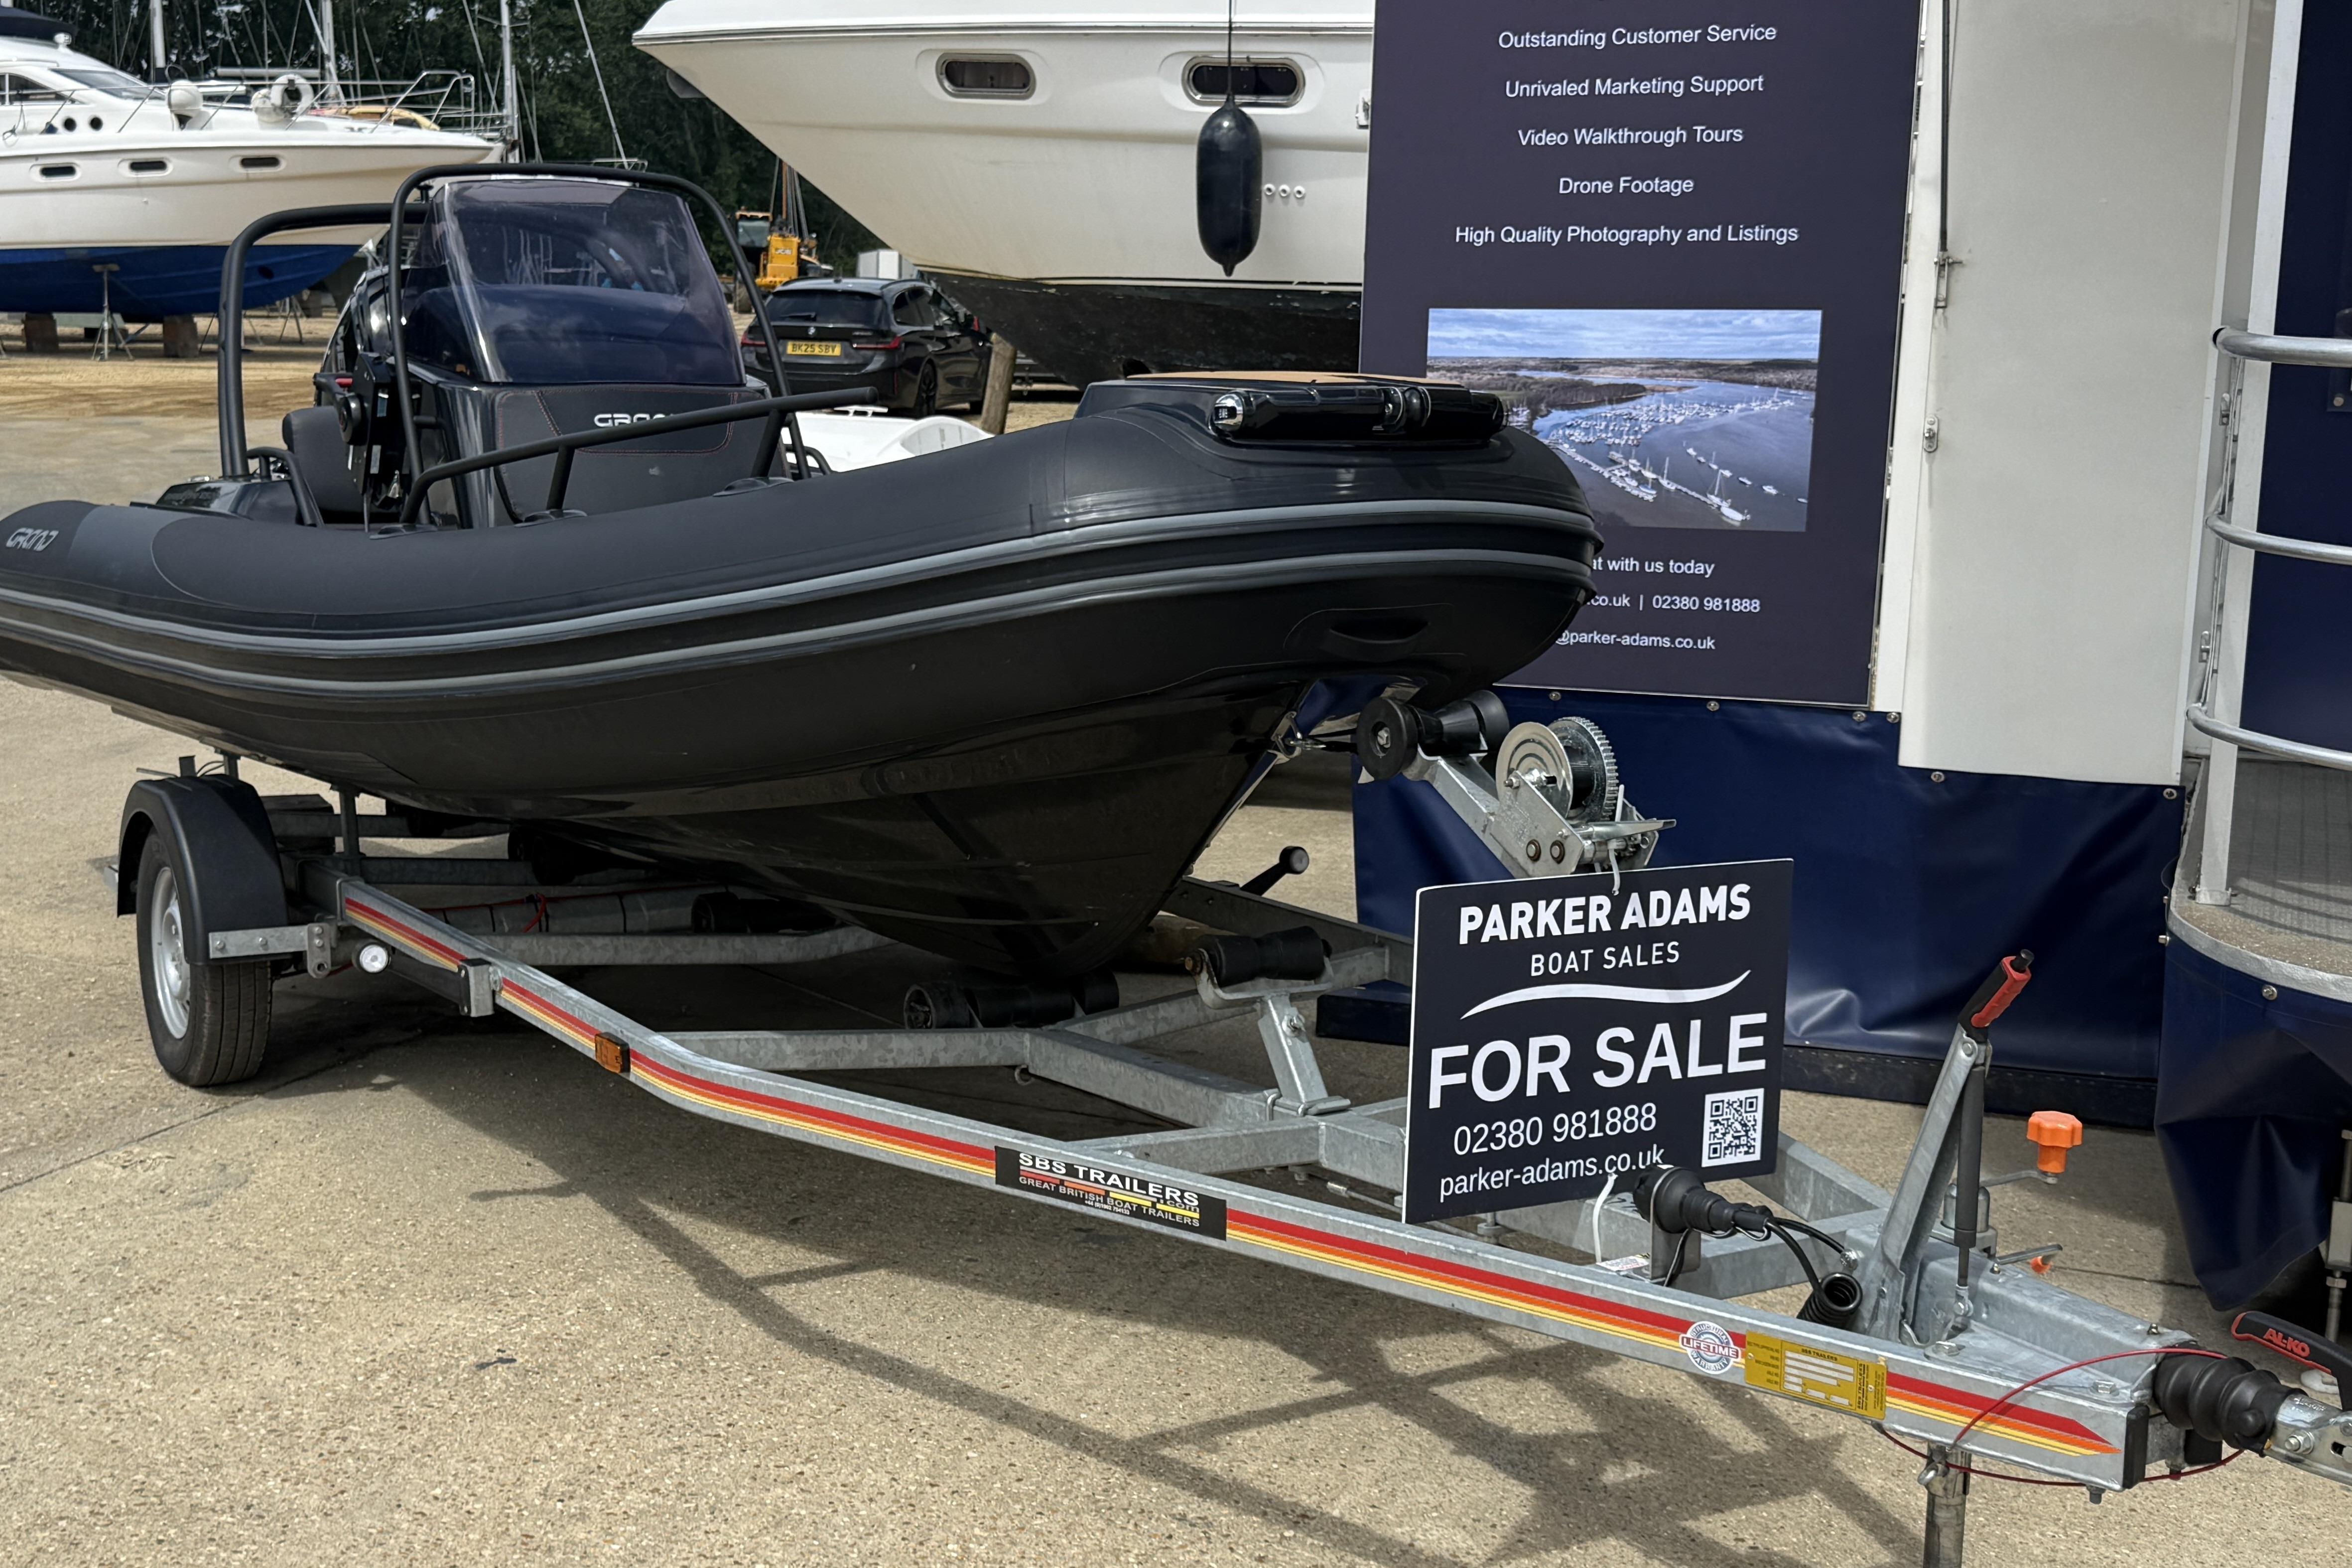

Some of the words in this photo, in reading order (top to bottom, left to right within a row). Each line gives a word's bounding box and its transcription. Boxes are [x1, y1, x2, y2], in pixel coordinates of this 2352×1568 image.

[1498, 29, 1606, 50] Outstanding
[1611, 27, 1702, 45] Customer
[1706, 24, 1777, 42] Service
[1505, 78, 1589, 98] Unrivaled
[1594, 76, 1684, 97] Marketing
[1690, 75, 1764, 96] Support
[1518, 129, 1568, 146] Video
[1573, 127, 1687, 147] Walkthrough
[1693, 125, 1743, 143] Tours
[1559, 177, 1613, 194] Drone
[1619, 176, 1694, 197] Footage
[1455, 226, 1495, 247] High
[1500, 226, 1563, 247] Quality
[1567, 225, 1682, 246] Photography
[1687, 224, 1721, 242] and
[1727, 224, 1798, 245] Listings
[791, 343, 816, 353] BK25
[1607, 557, 1640, 572] with
[1645, 561, 1664, 573] us
[1669, 559, 1715, 578] today
[1652, 595, 1699, 610] 02380
[1703, 597, 1760, 613] 981888
[1459, 895, 1612, 945] PARKER
[1620, 884, 1751, 930] ADAMS
[1530, 949, 1594, 976] BOAT
[1603, 941, 1680, 969] SALES
[1428, 1034, 1571, 1109] FOR
[1592, 1012, 1768, 1088] SALE
[1453, 1116, 1543, 1156] 02380
[1553, 1102, 1657, 1143] 981888
[1019, 1153, 1066, 1175] SBS
[1073, 1165, 1199, 1206] TRAILERS
[1440, 1144, 1665, 1202] parker-adams.co.uk
[1019, 1176, 1056, 1191] GREAT
[1058, 1185, 1104, 1203] BRITISH
[1107, 1197, 1138, 1211] BOAT
[1141, 1205, 1200, 1227] TRAILERS
[1160, 1199, 1200, 1213] .com
[1690, 1323, 1728, 1344] STRUCTURAL
[2263, 1328, 2311, 1358] AL-KO
[1683, 1337, 1737, 1358] LIFETIME
[1691, 1350, 1728, 1371] WARRANTY
